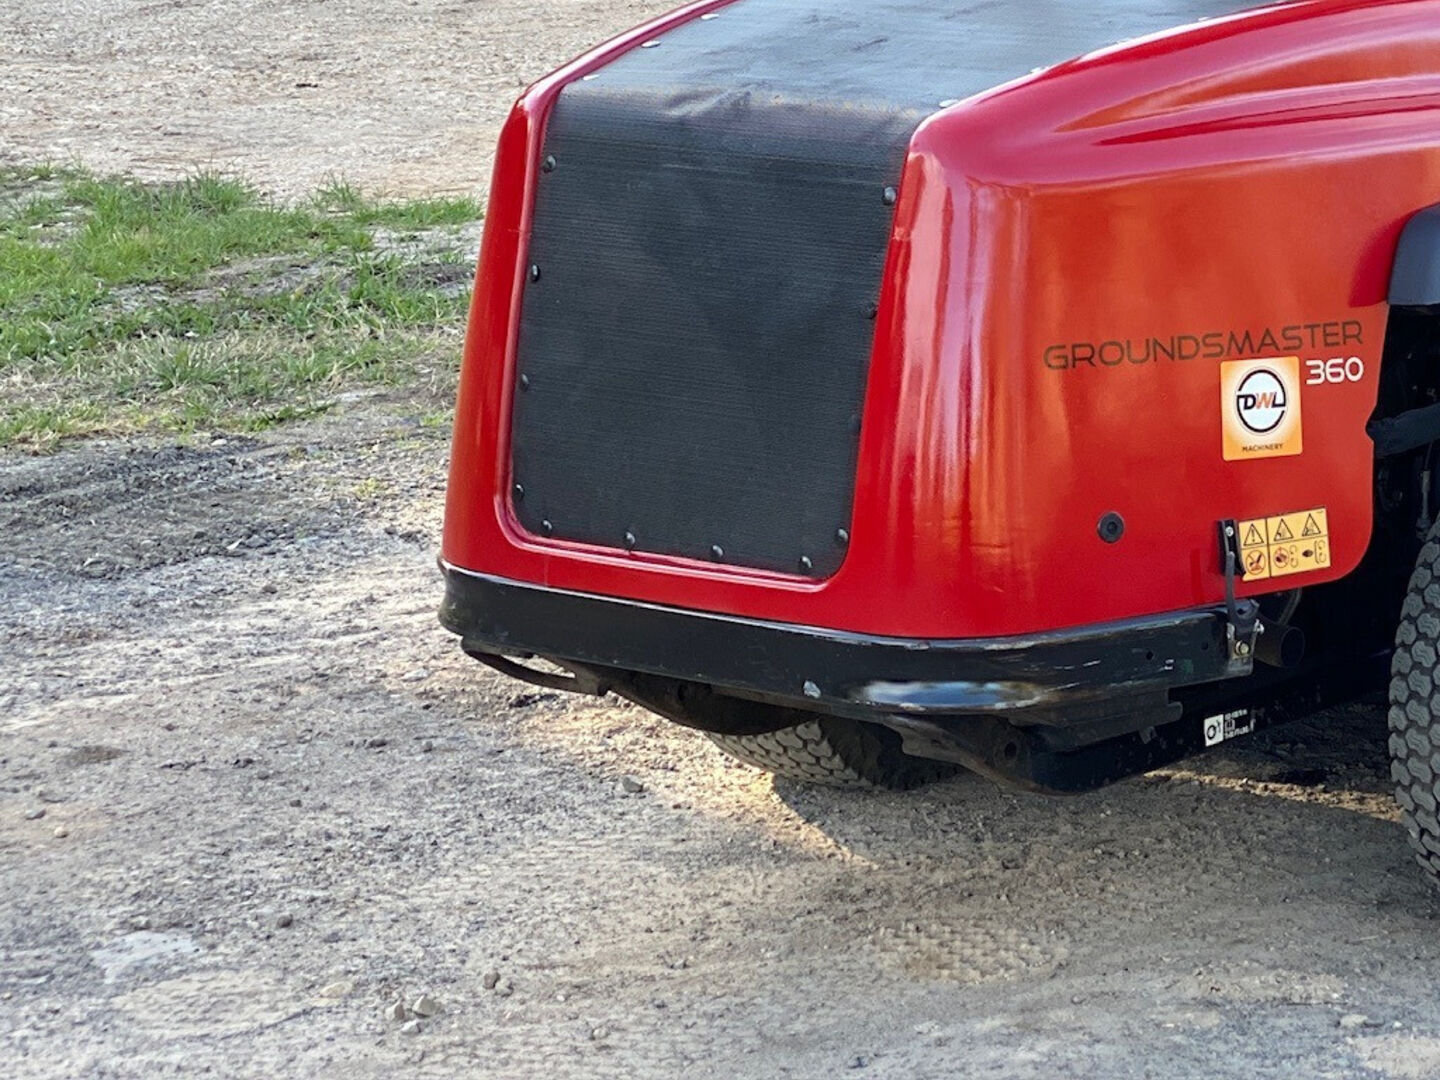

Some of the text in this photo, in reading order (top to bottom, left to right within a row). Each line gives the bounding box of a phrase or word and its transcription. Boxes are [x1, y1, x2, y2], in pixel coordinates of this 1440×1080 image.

[1043, 320, 1364, 370] GROUNDSMASTER
[1305, 357, 1365, 385] 360
[1241, 443, 1283, 452] MACHINERY
